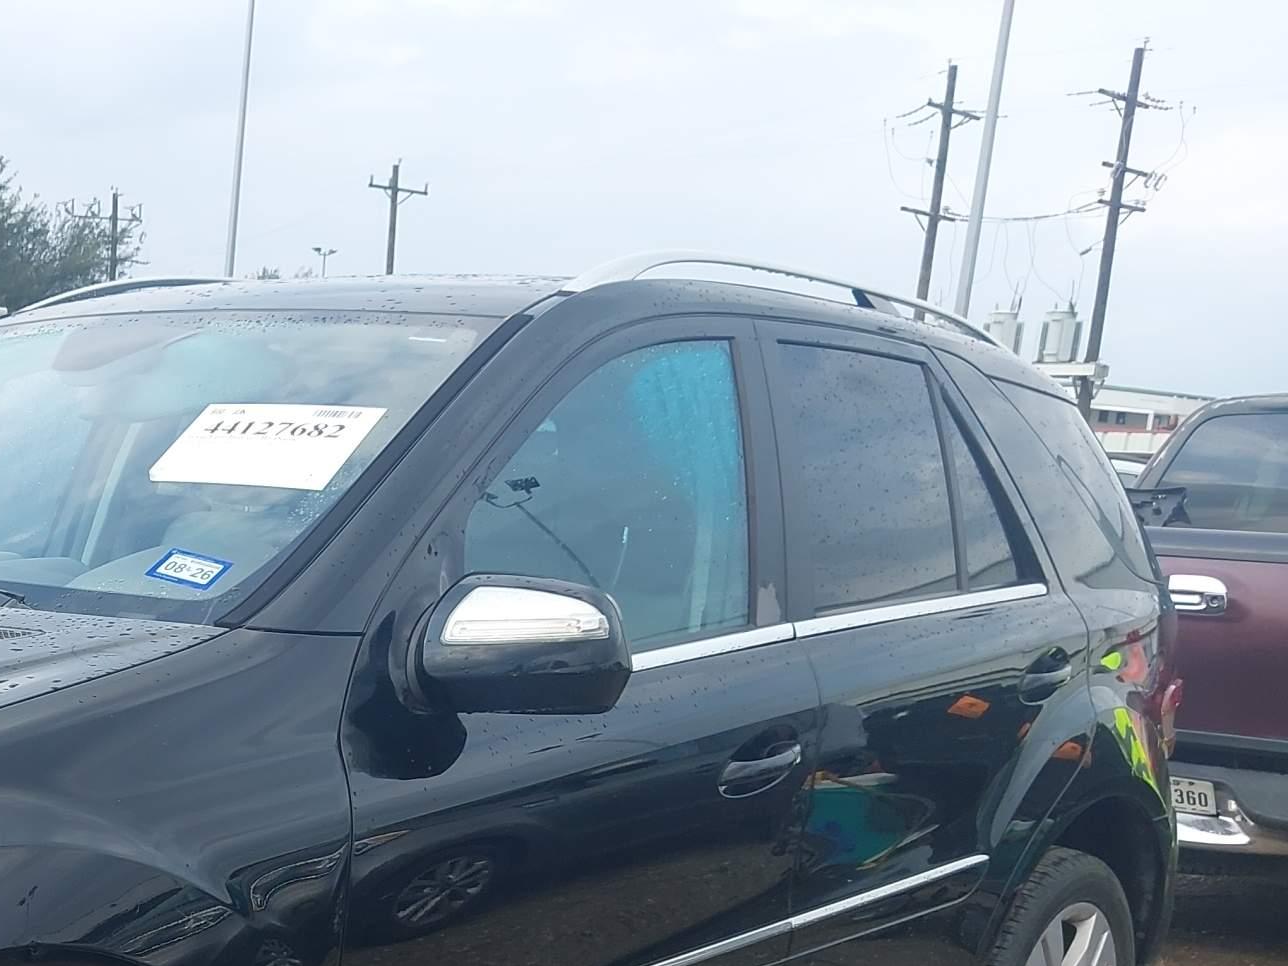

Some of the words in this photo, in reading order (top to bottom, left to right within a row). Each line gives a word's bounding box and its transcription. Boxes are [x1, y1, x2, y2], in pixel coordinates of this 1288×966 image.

[203, 420, 346, 439] 44127682
[164, 560, 187, 573] 08
[189, 567, 214, 580] 26
[1174, 788, 1208, 807] 360
